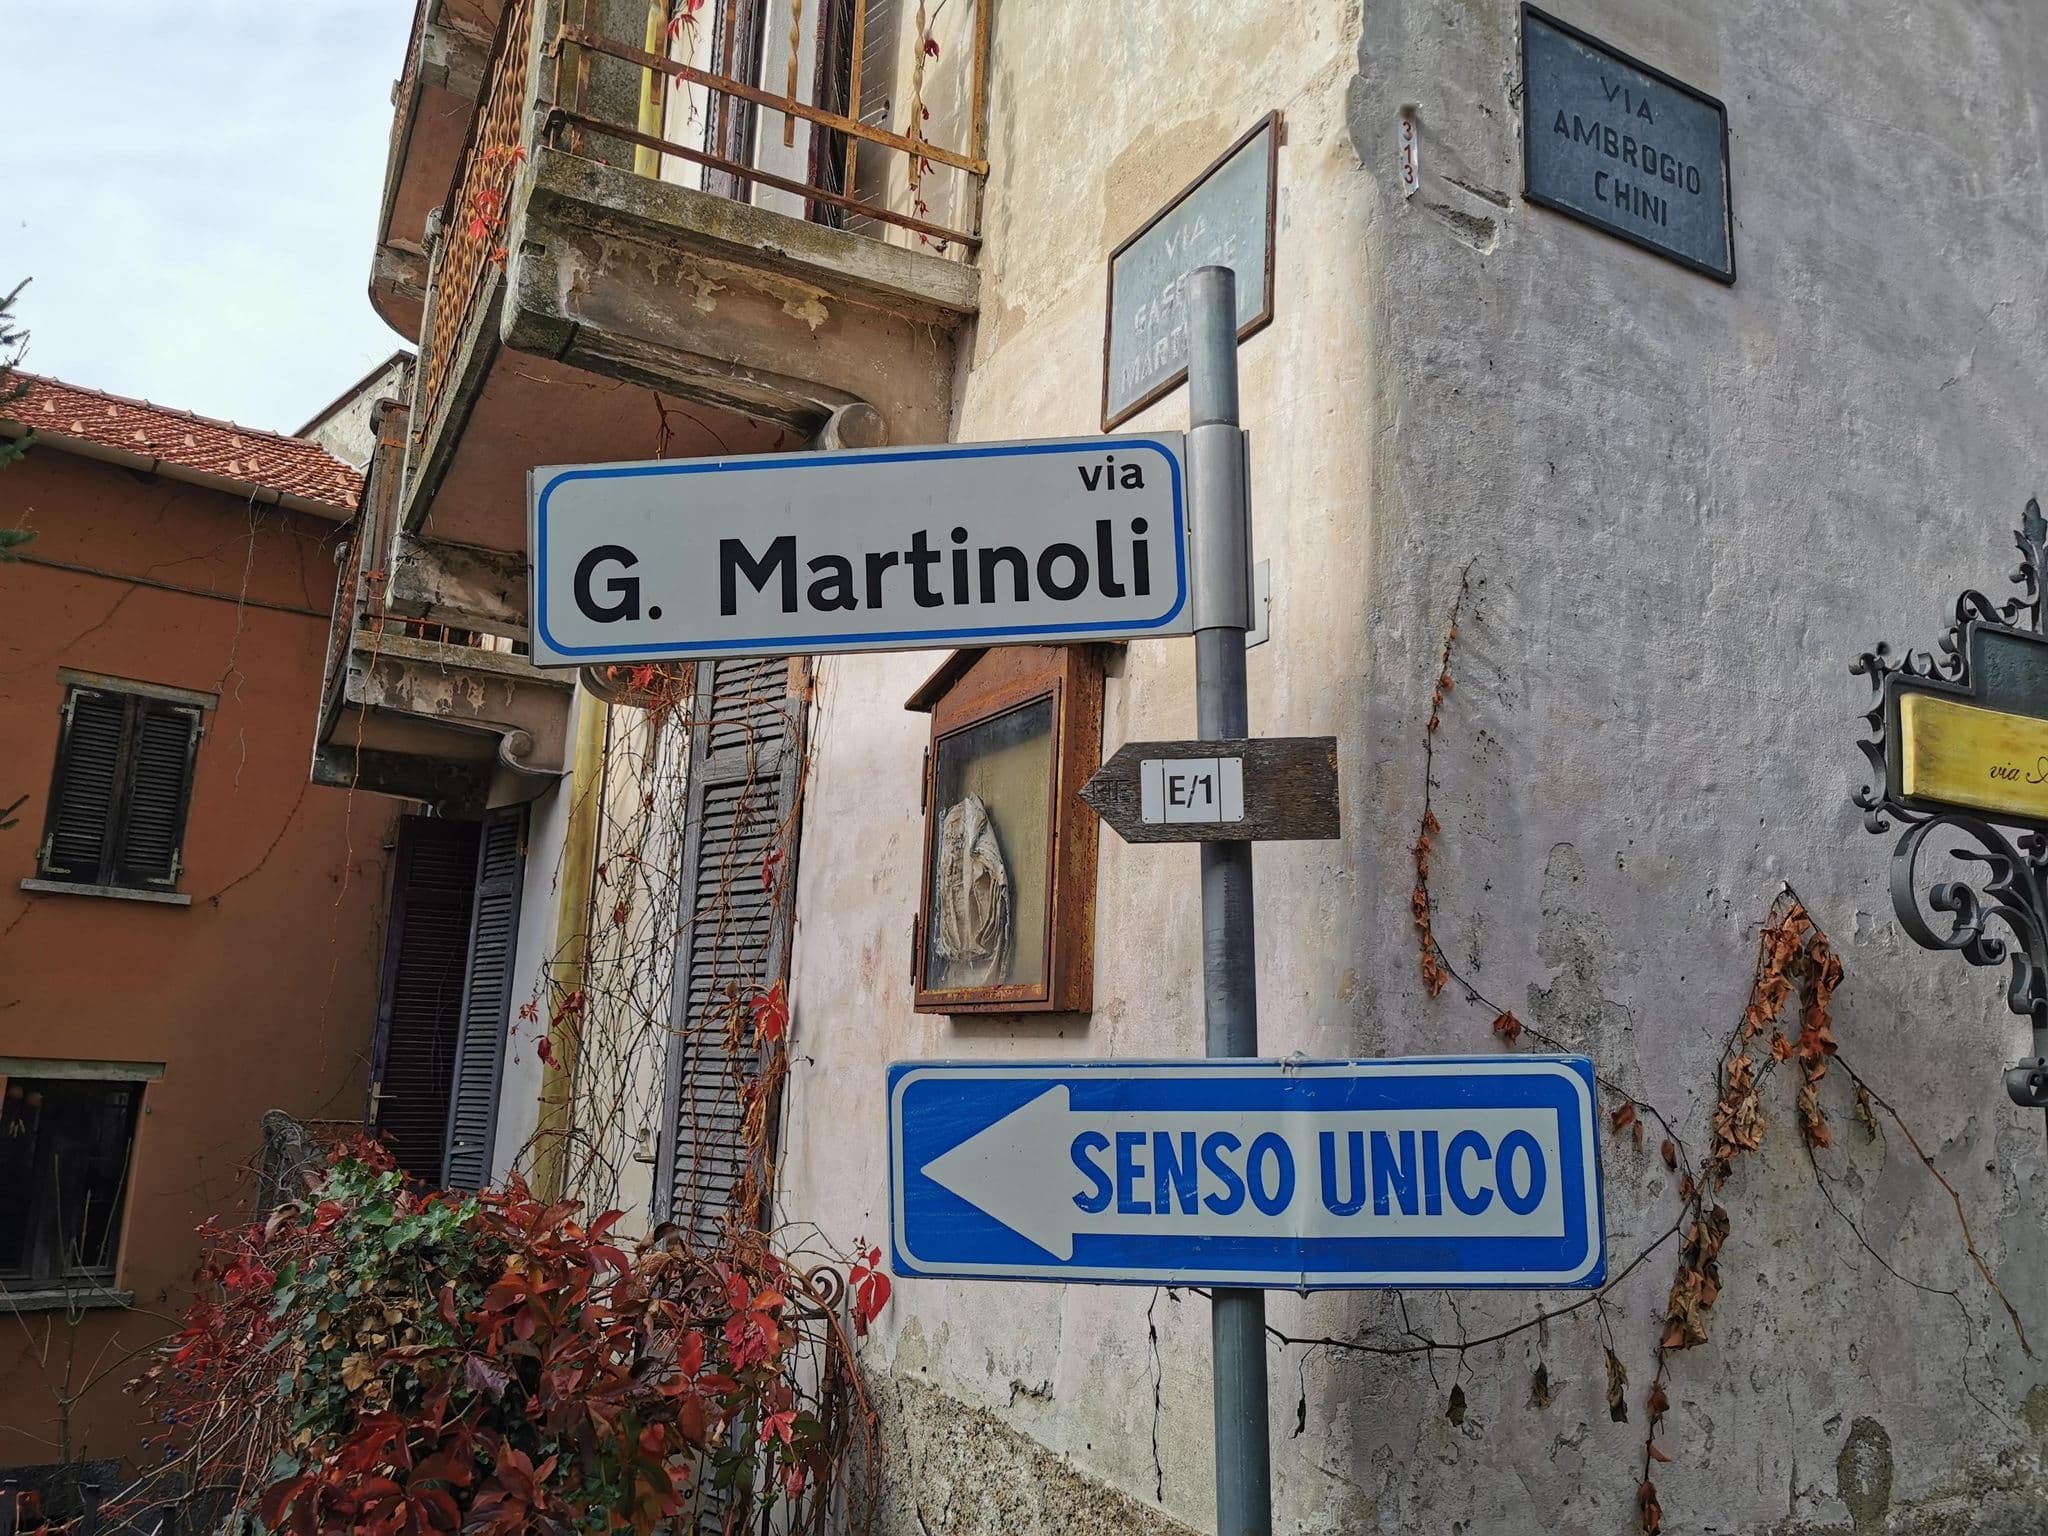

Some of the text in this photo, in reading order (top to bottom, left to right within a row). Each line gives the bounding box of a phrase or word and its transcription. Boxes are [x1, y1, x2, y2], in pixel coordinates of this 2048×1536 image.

[1600, 76, 1654, 125] VIA
[1553, 109, 1700, 196] AMBROGIO
[1594, 170, 1668, 227] CHINI
[1165, 215, 1207, 260] VIA
[1078, 455, 1145, 491] via
[574, 516, 1151, 624] G. Martinoli
[1168, 774, 1212, 808] E/1
[1990, 762, 2020, 781] via
[1070, 1129, 1546, 1216] SENSO UNICO
